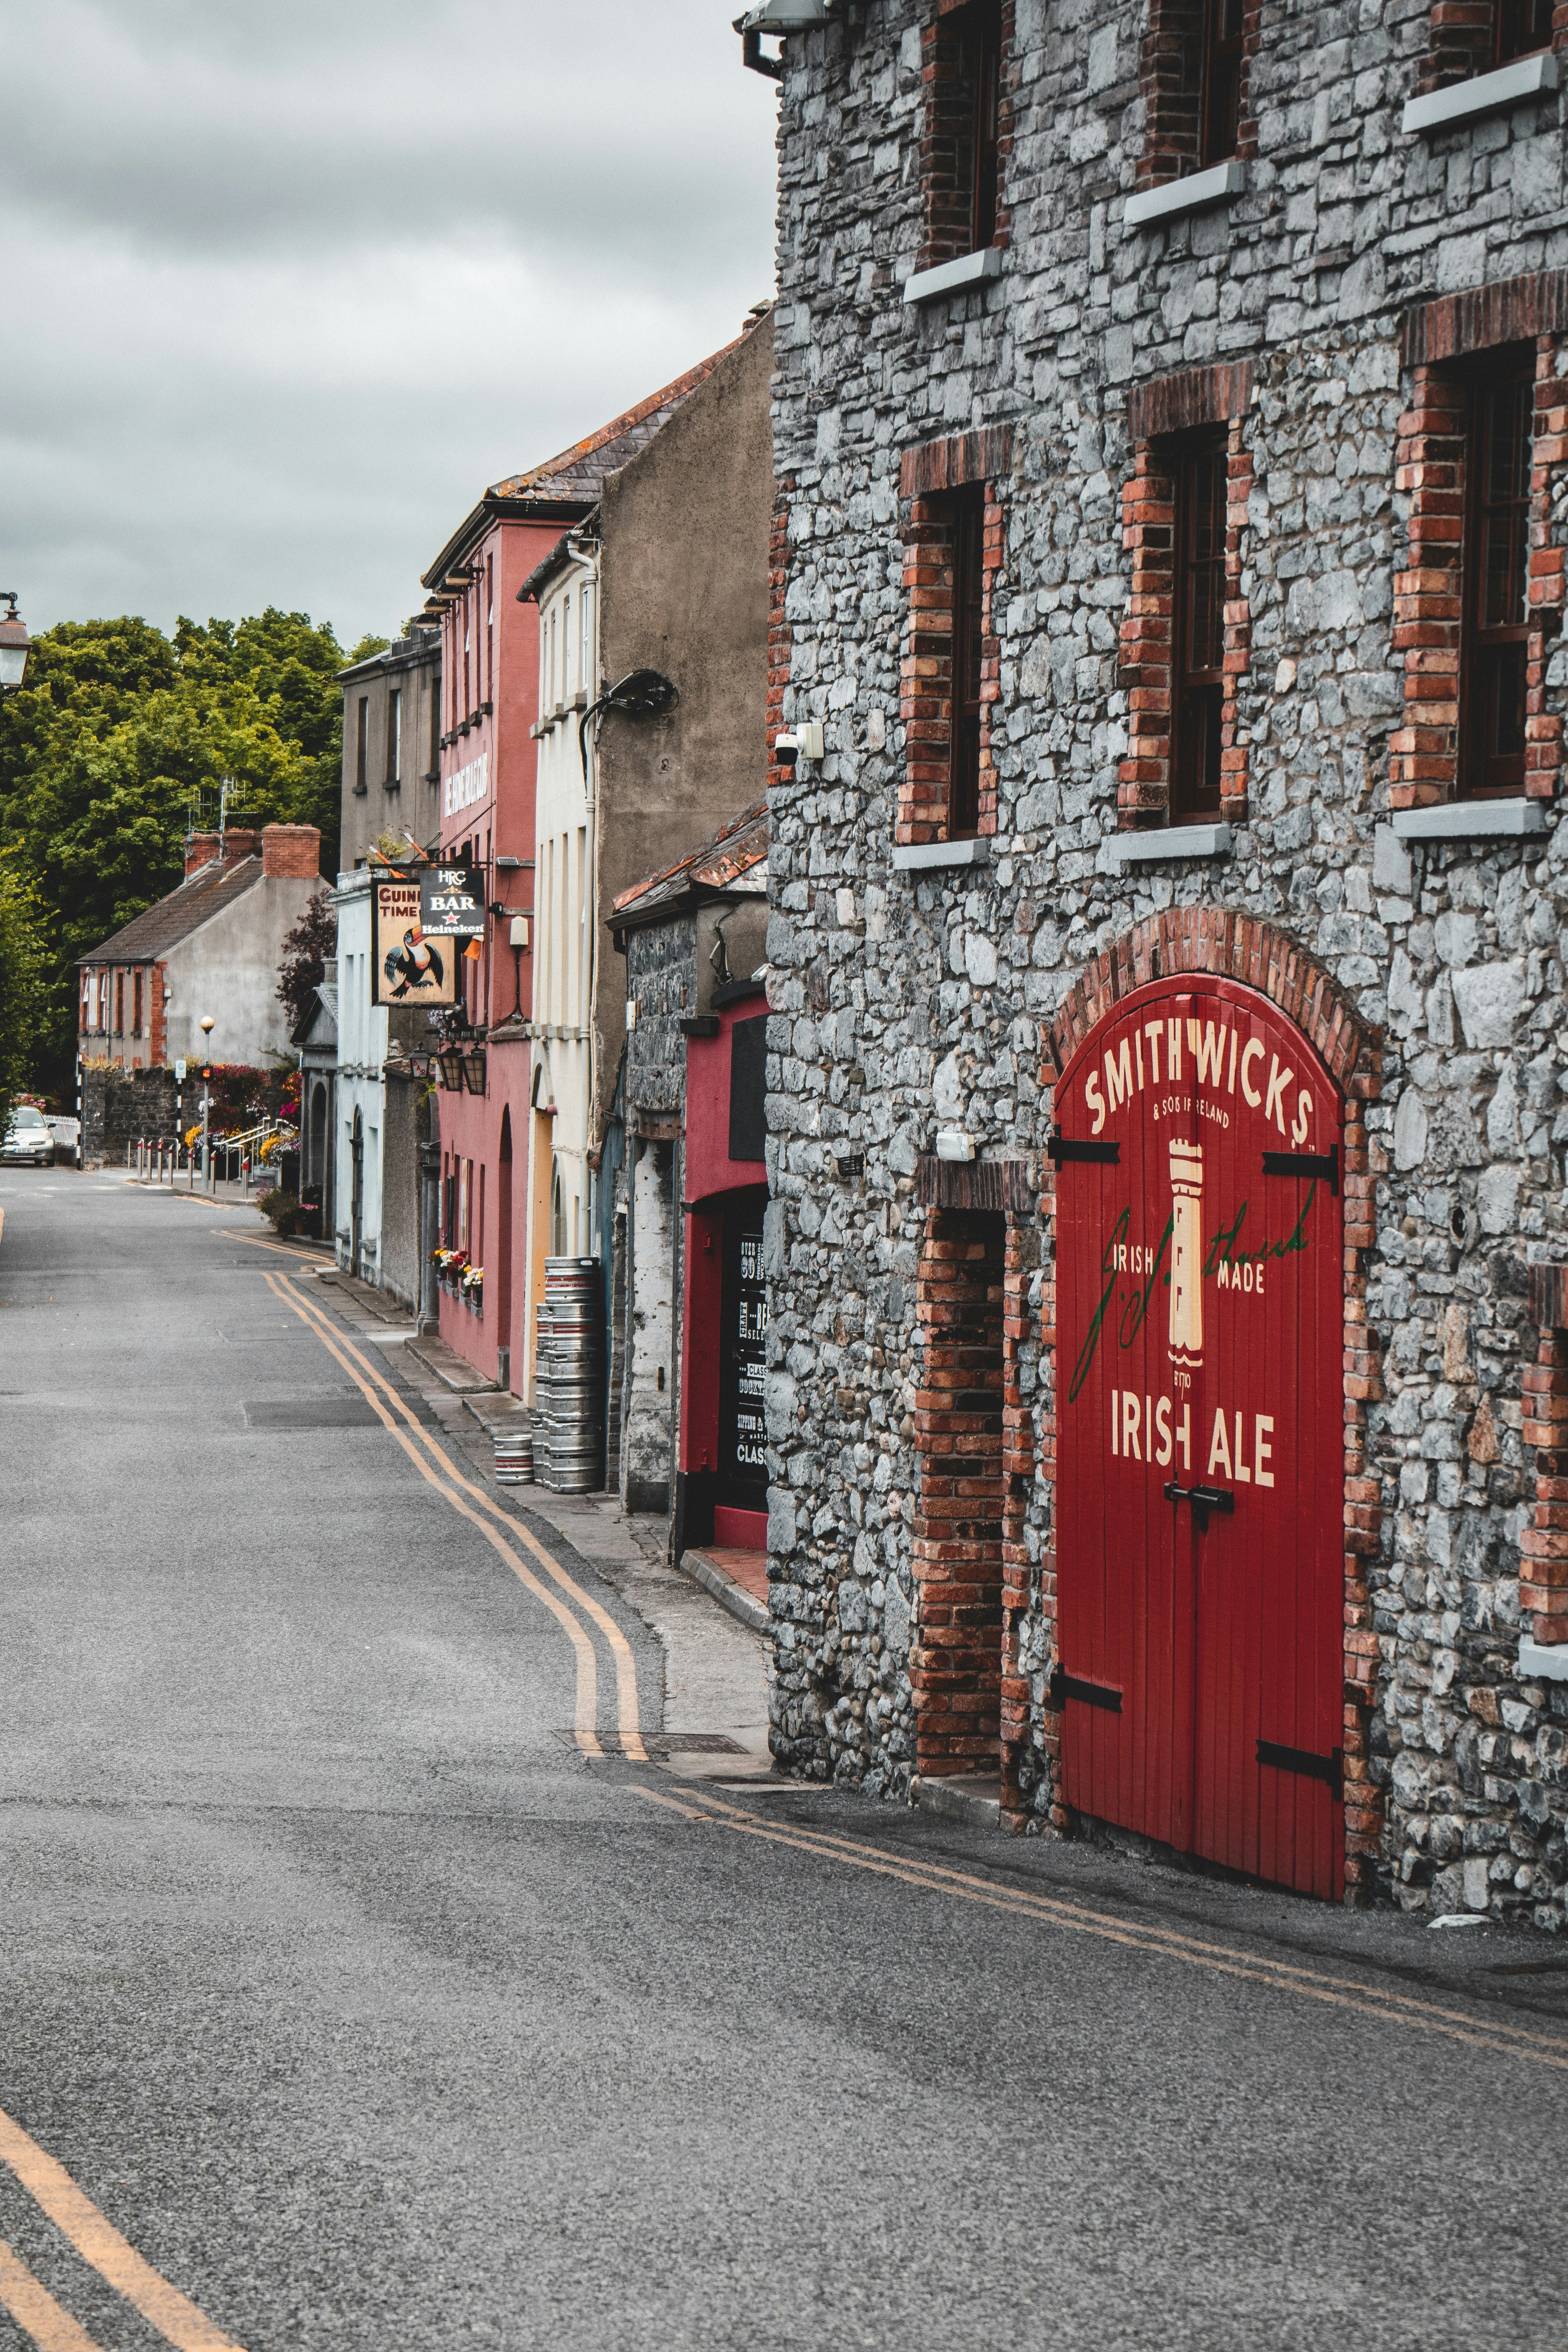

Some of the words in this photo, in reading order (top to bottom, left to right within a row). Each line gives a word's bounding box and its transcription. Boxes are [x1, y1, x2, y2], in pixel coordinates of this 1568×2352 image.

[439, 870, 466, 886] HRC
[380, 906, 417, 916] TIME
[430, 897, 476, 911] BAR
[422, 924, 485, 934] Heineken
[413, 1060, 426, 1076] BAR
[1154, 1103, 1159, 1120] &
[741, 1242, 755, 1256] OVER
[1113, 1243, 1153, 1275] IRISH
[1217, 1259, 1265, 1294] MADE
[737, 1414, 756, 1430] SIPPING
[1111, 1389, 1191, 1470] IRISH
[1207, 1407, 1274, 1488] ALE
